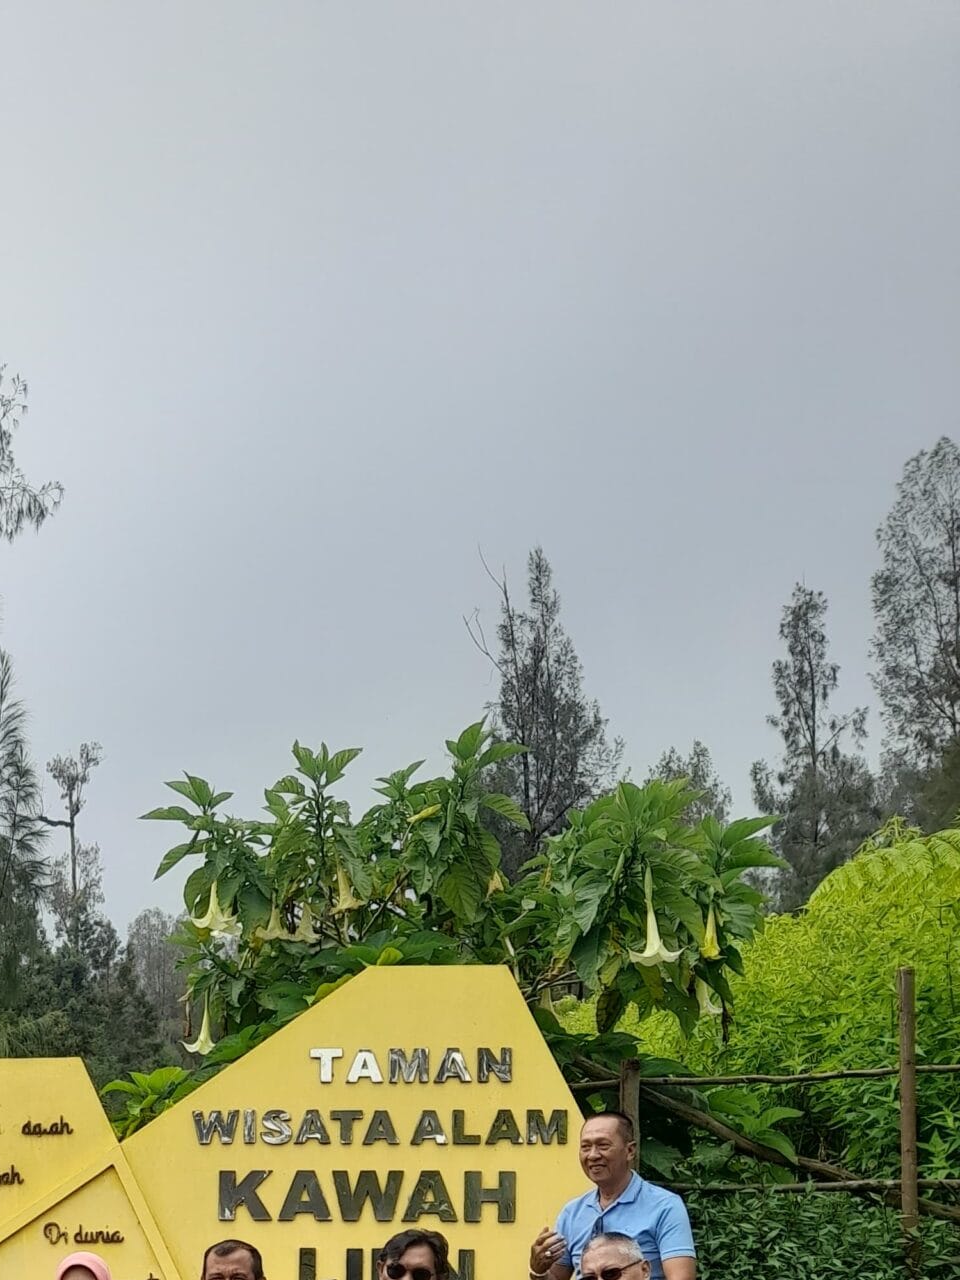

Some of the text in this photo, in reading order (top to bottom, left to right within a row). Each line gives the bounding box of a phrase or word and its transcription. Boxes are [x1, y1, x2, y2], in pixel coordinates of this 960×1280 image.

[309, 1047, 513, 1084] TAMAN
[192, 1109, 568, 1146] WISATA ALAM
[217, 1169, 517, 1223] KAWAH
